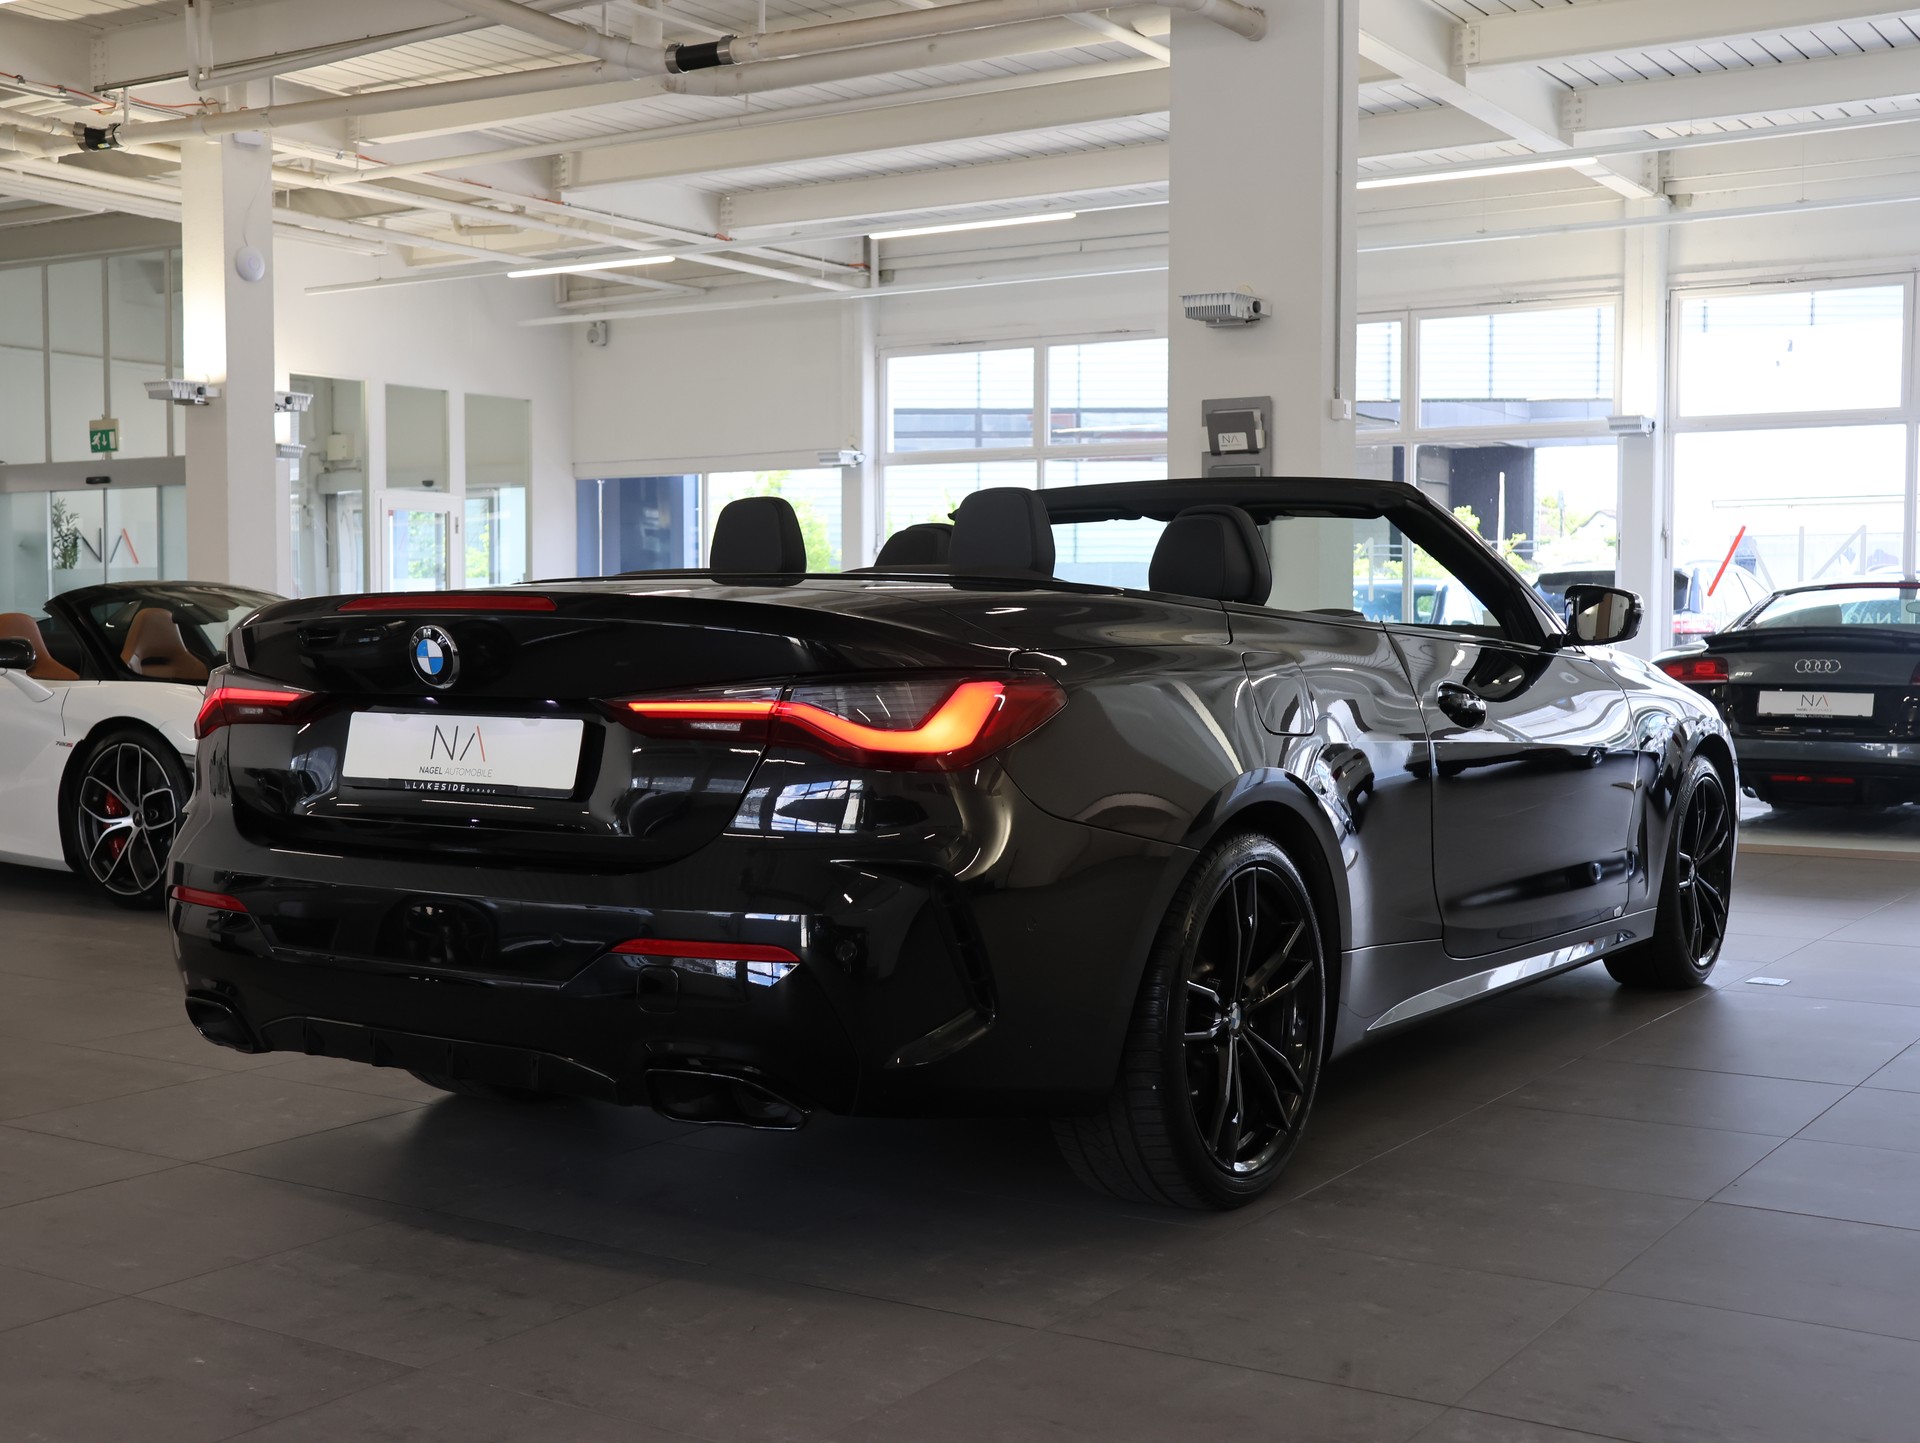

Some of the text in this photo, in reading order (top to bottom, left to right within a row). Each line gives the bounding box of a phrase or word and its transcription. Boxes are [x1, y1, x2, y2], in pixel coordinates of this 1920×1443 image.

[412, 628, 447, 648] BMW
[430, 725, 486, 762] NA
[419, 766, 493, 777] NAGEL AUTOMOBILE
[412, 782, 465, 791] LAKESIDE
